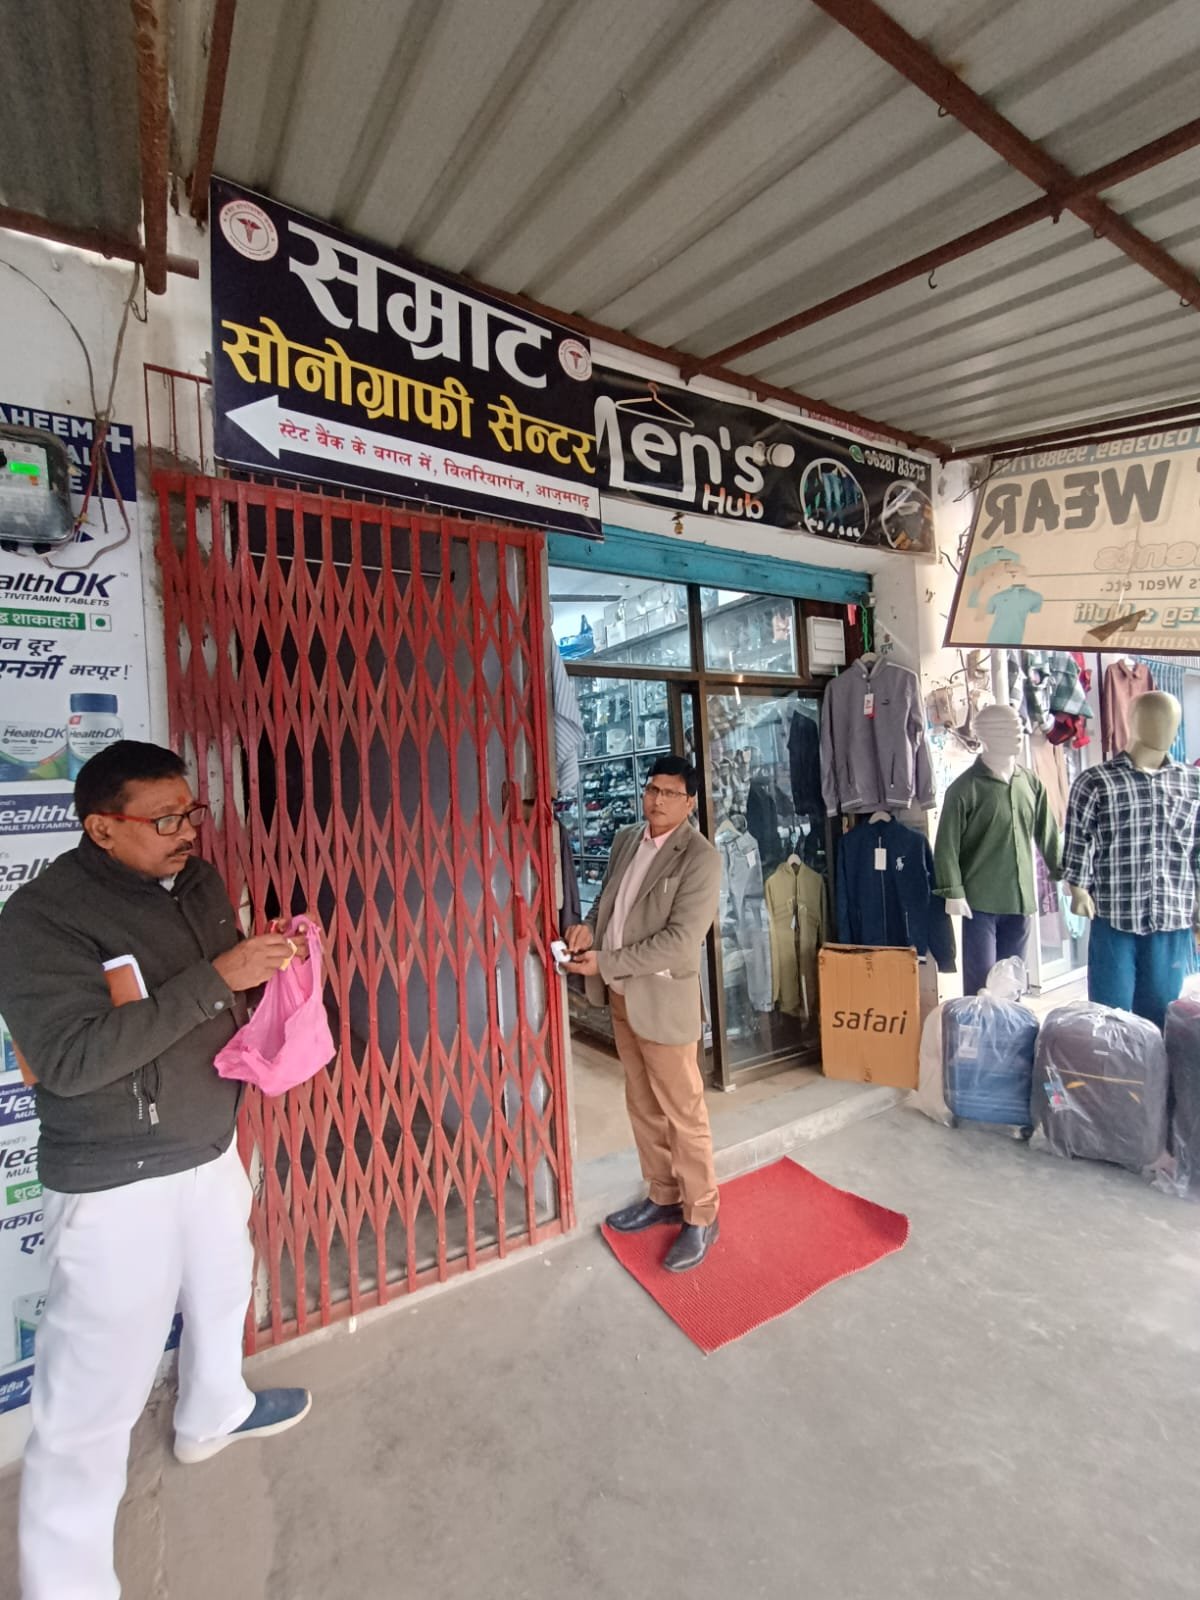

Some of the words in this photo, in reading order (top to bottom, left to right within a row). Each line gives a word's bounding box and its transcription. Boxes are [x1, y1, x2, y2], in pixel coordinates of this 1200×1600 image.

[288, 220, 552, 389] सम्राट
[221, 316, 474, 438] सोनोग्राफी
[488, 395, 596, 474] सेन्टर
[279, 418, 310, 442] स्टेट
[315, 423, 345, 450] बैंक
[351, 436, 367, 456] के
[703, 484, 764, 520] Hub
[64, 596, 110, 607] TABLETS
[12, 613, 80, 629] शाकाहारी
[28, 638, 57, 656] दूर
[4, 727, 67, 739] HealthOK
[832, 1007, 908, 1035] safari
